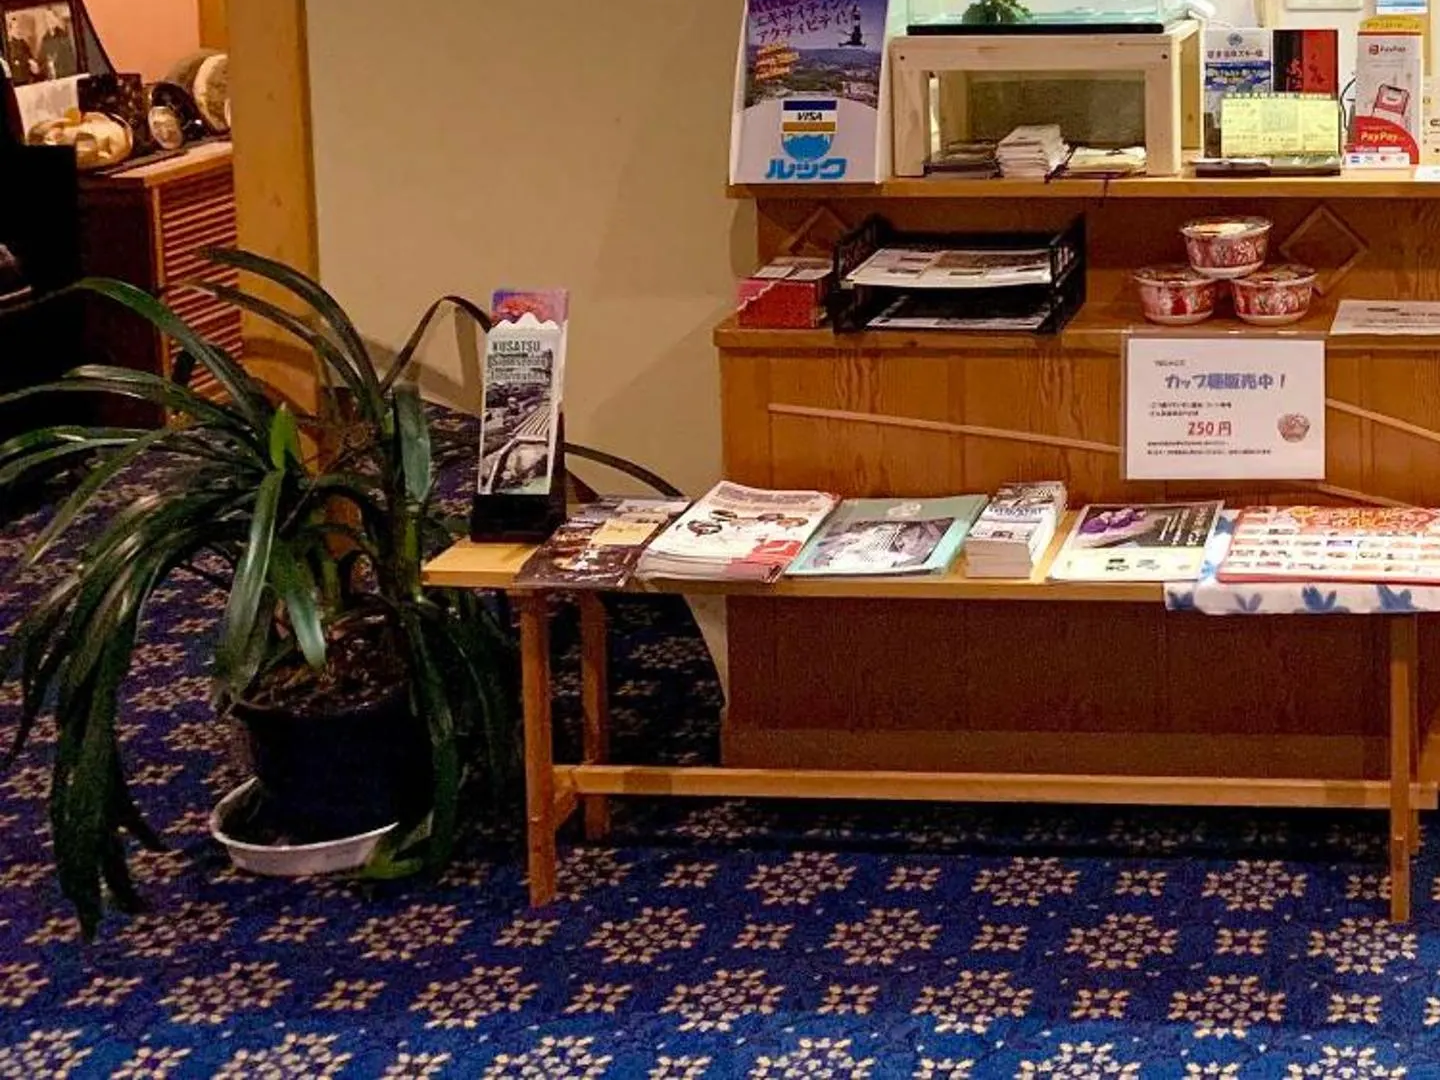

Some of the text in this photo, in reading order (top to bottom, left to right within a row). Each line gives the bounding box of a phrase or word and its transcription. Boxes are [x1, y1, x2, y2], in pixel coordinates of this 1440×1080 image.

[797, 111, 823, 121] VISA
[1360, 131, 1399, 144] PayPay
[1187, 420, 1232, 437] 250円
